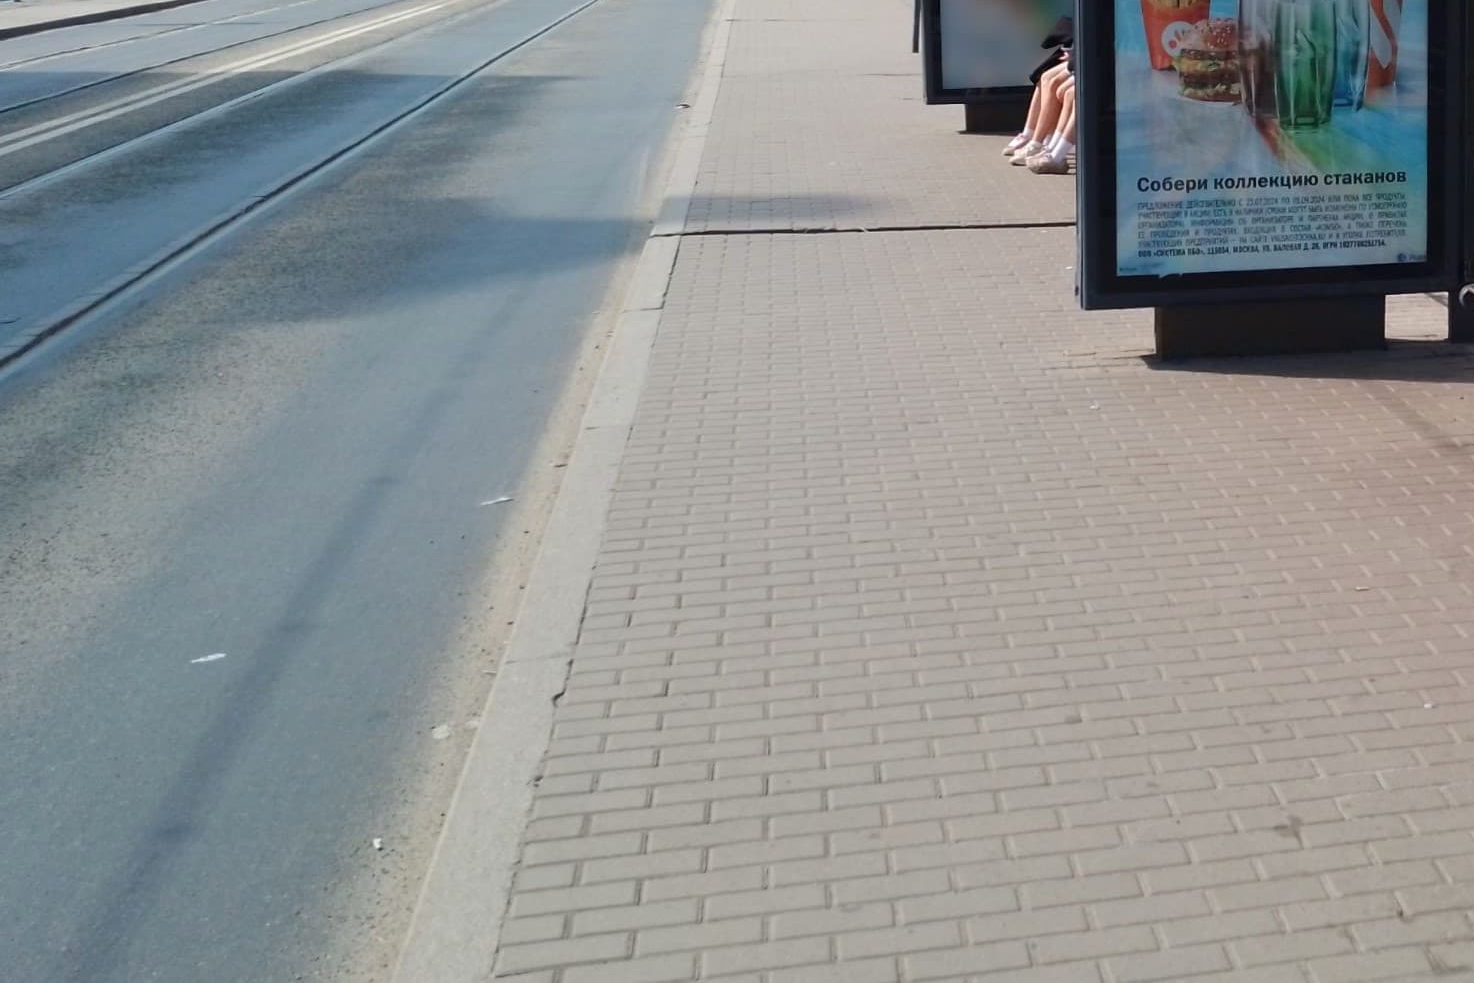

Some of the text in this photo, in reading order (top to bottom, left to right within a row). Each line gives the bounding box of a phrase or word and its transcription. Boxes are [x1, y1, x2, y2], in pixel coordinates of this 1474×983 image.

[1136, 170, 1407, 193] Собери коллекцию стаканов
